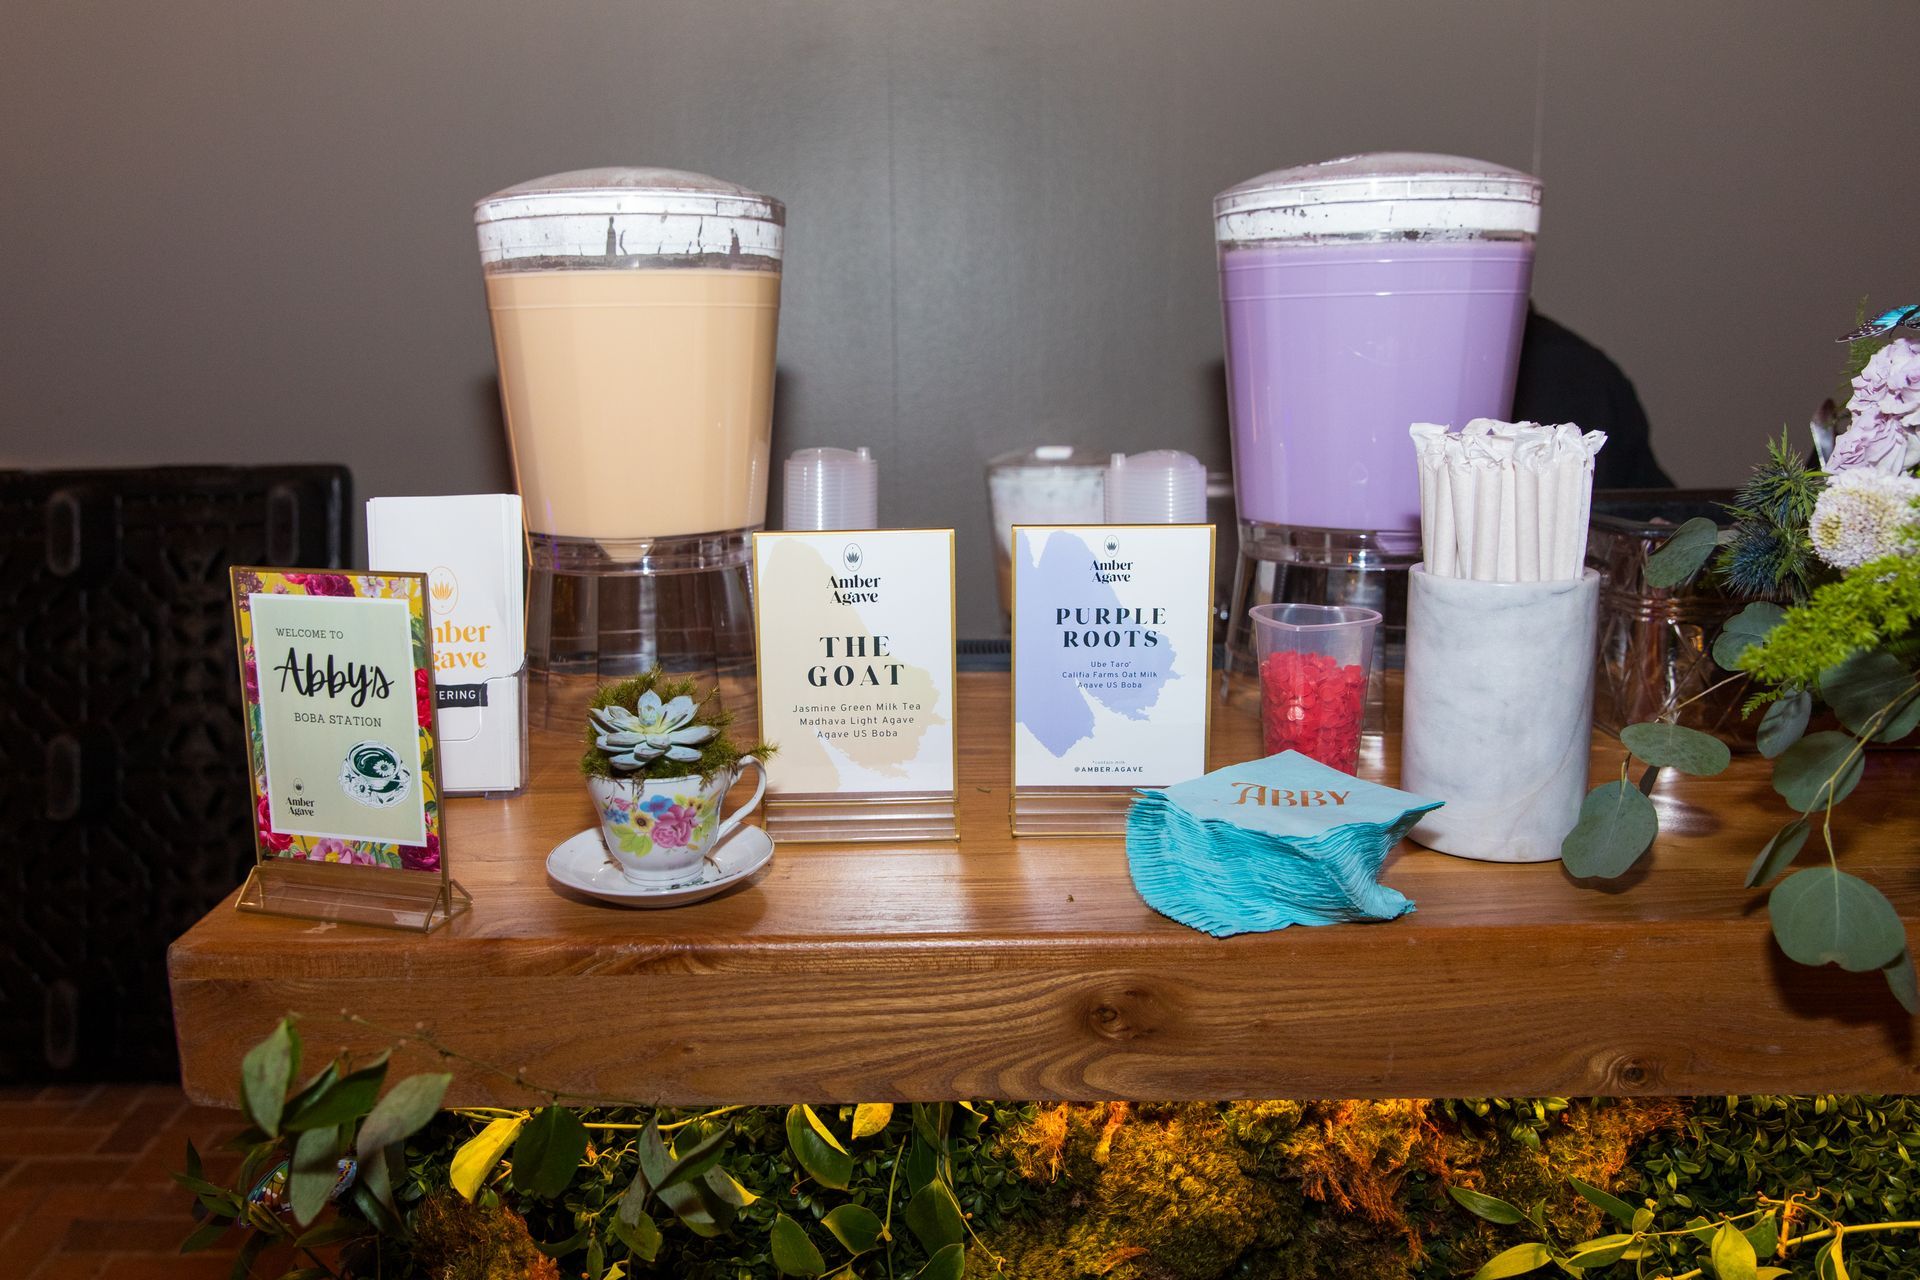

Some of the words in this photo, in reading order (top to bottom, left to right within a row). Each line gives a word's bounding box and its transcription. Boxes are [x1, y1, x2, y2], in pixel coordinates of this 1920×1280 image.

[1089, 559, 1134, 571] Amber
[826, 574, 881, 589] Amber
[1092, 572, 1131, 584] Agave
[830, 590, 879, 606] Agave
[1056, 607, 1166, 625] PURPLE
[275, 628, 327, 639] WELCOME
[329, 631, 344, 639] TO
[1063, 630, 1158, 648] ROOTS
[819, 635, 890, 658] THE
[273, 647, 394, 707] Abby's
[807, 664, 905, 687] GOAT
[792, 704, 836, 714] Jasmine
[840, 703, 872, 714] Green
[876, 703, 898, 712] Milk
[902, 702, 921, 712] Tea
[294, 712, 326, 724] BOBA
[329, 715, 382, 728] STATION
[800, 717, 846, 727] Madhava
[850, 716, 878, 728] Light
[882, 716, 915, 727] Agave
[817, 731, 850, 741] Agave
[853, 730, 868, 739] US
[872, 729, 898, 739] Boba
[286, 796, 315, 807] Amber
[1230, 782, 1350, 808] ABBY
[289, 806, 315, 816] Agave
